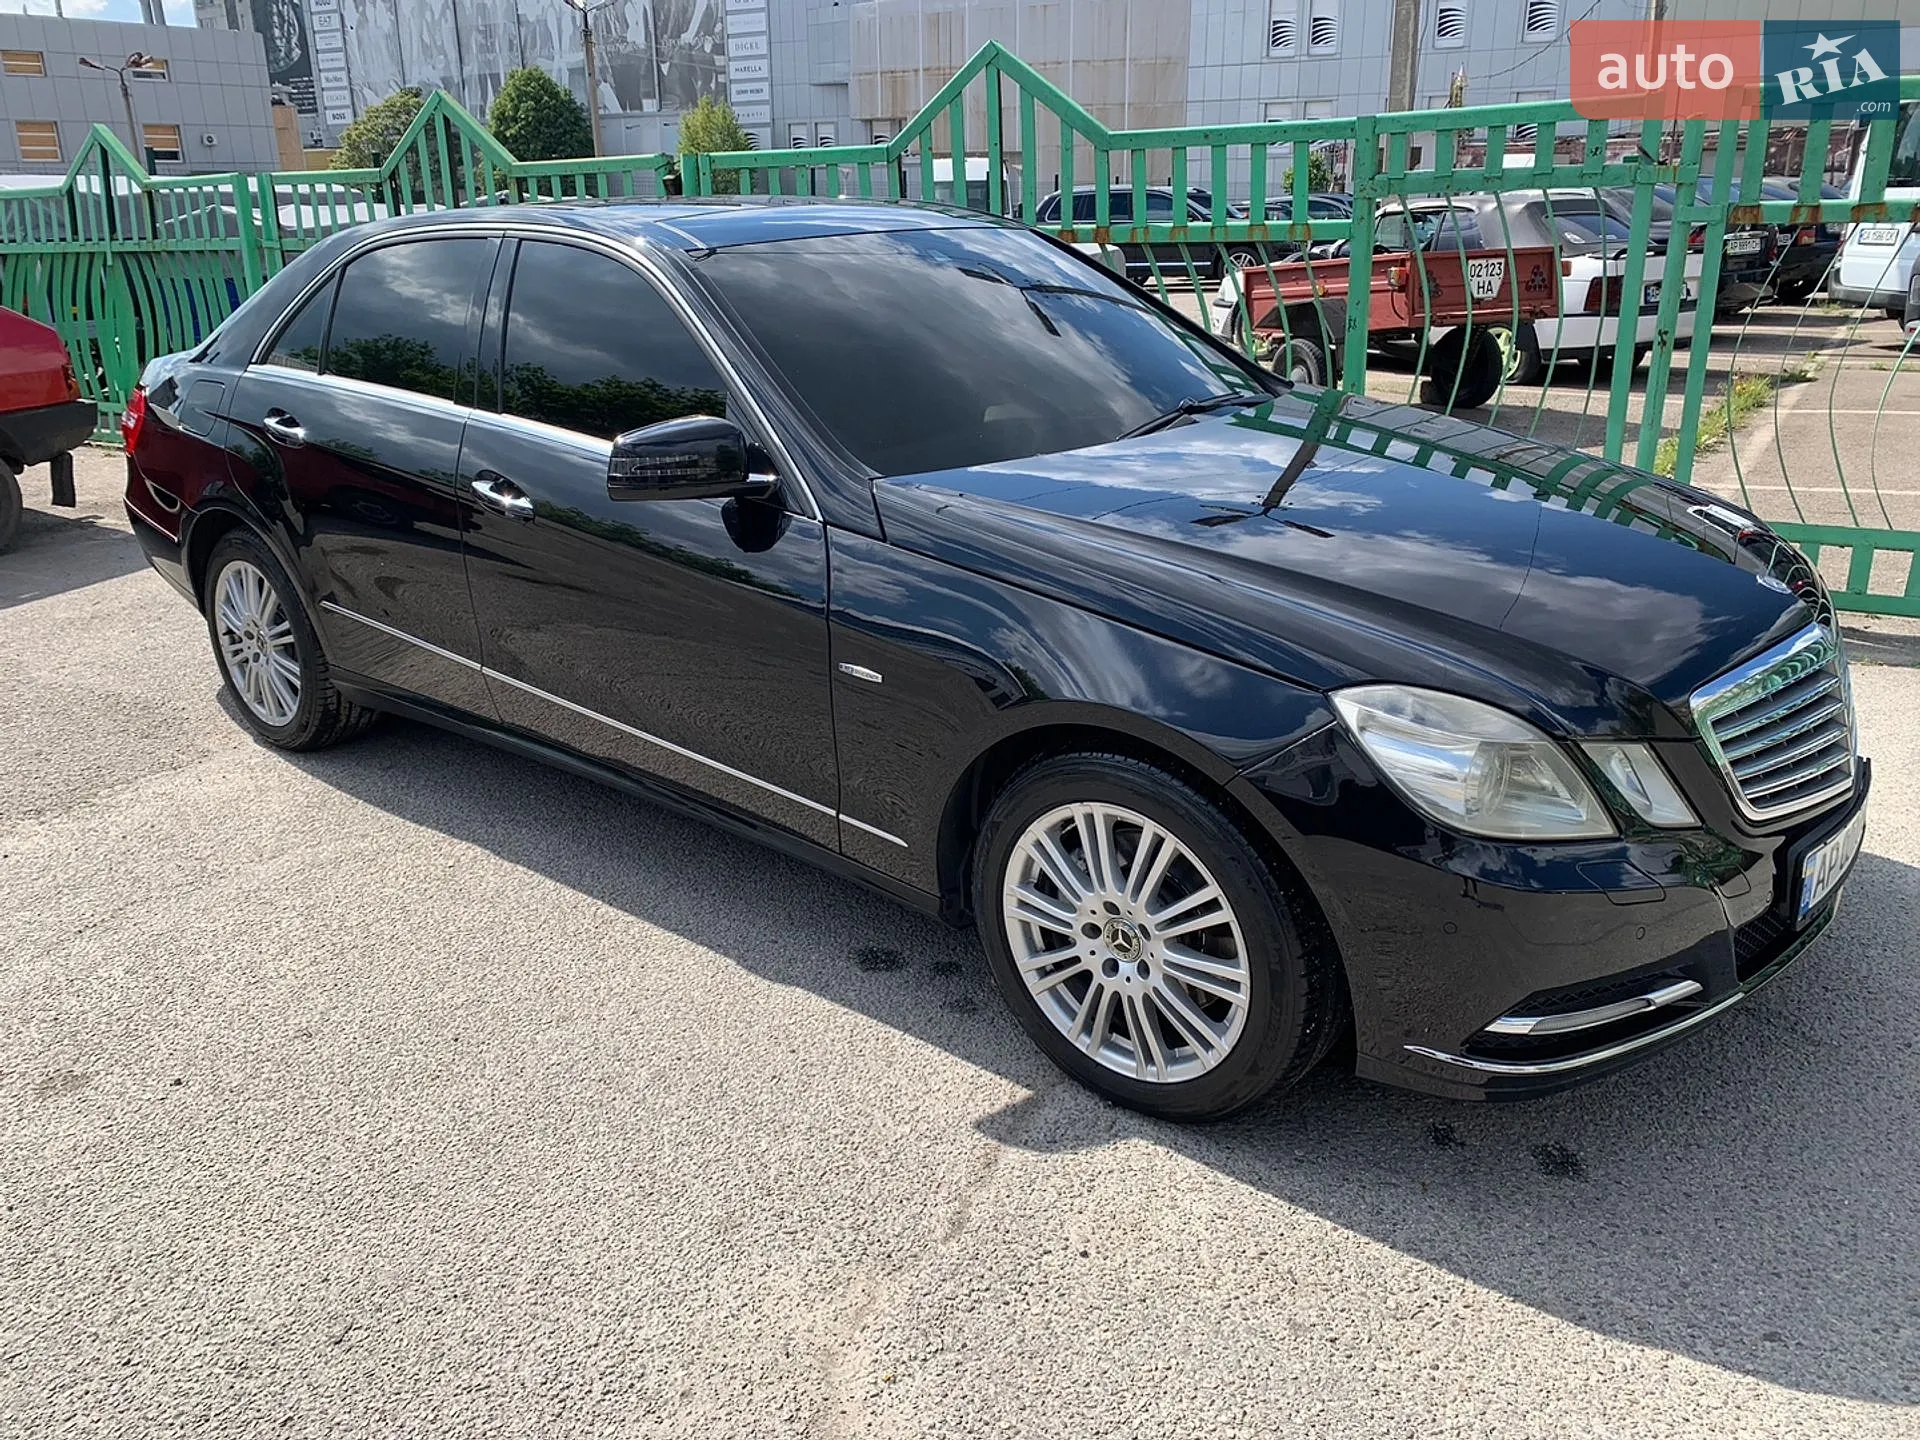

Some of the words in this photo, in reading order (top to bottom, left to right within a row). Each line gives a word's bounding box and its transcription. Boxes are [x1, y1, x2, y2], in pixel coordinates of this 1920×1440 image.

[735, 41, 760, 51] DIGEL
[1470, 261, 1503, 278] 02123
[1477, 280, 1493, 295] HA
